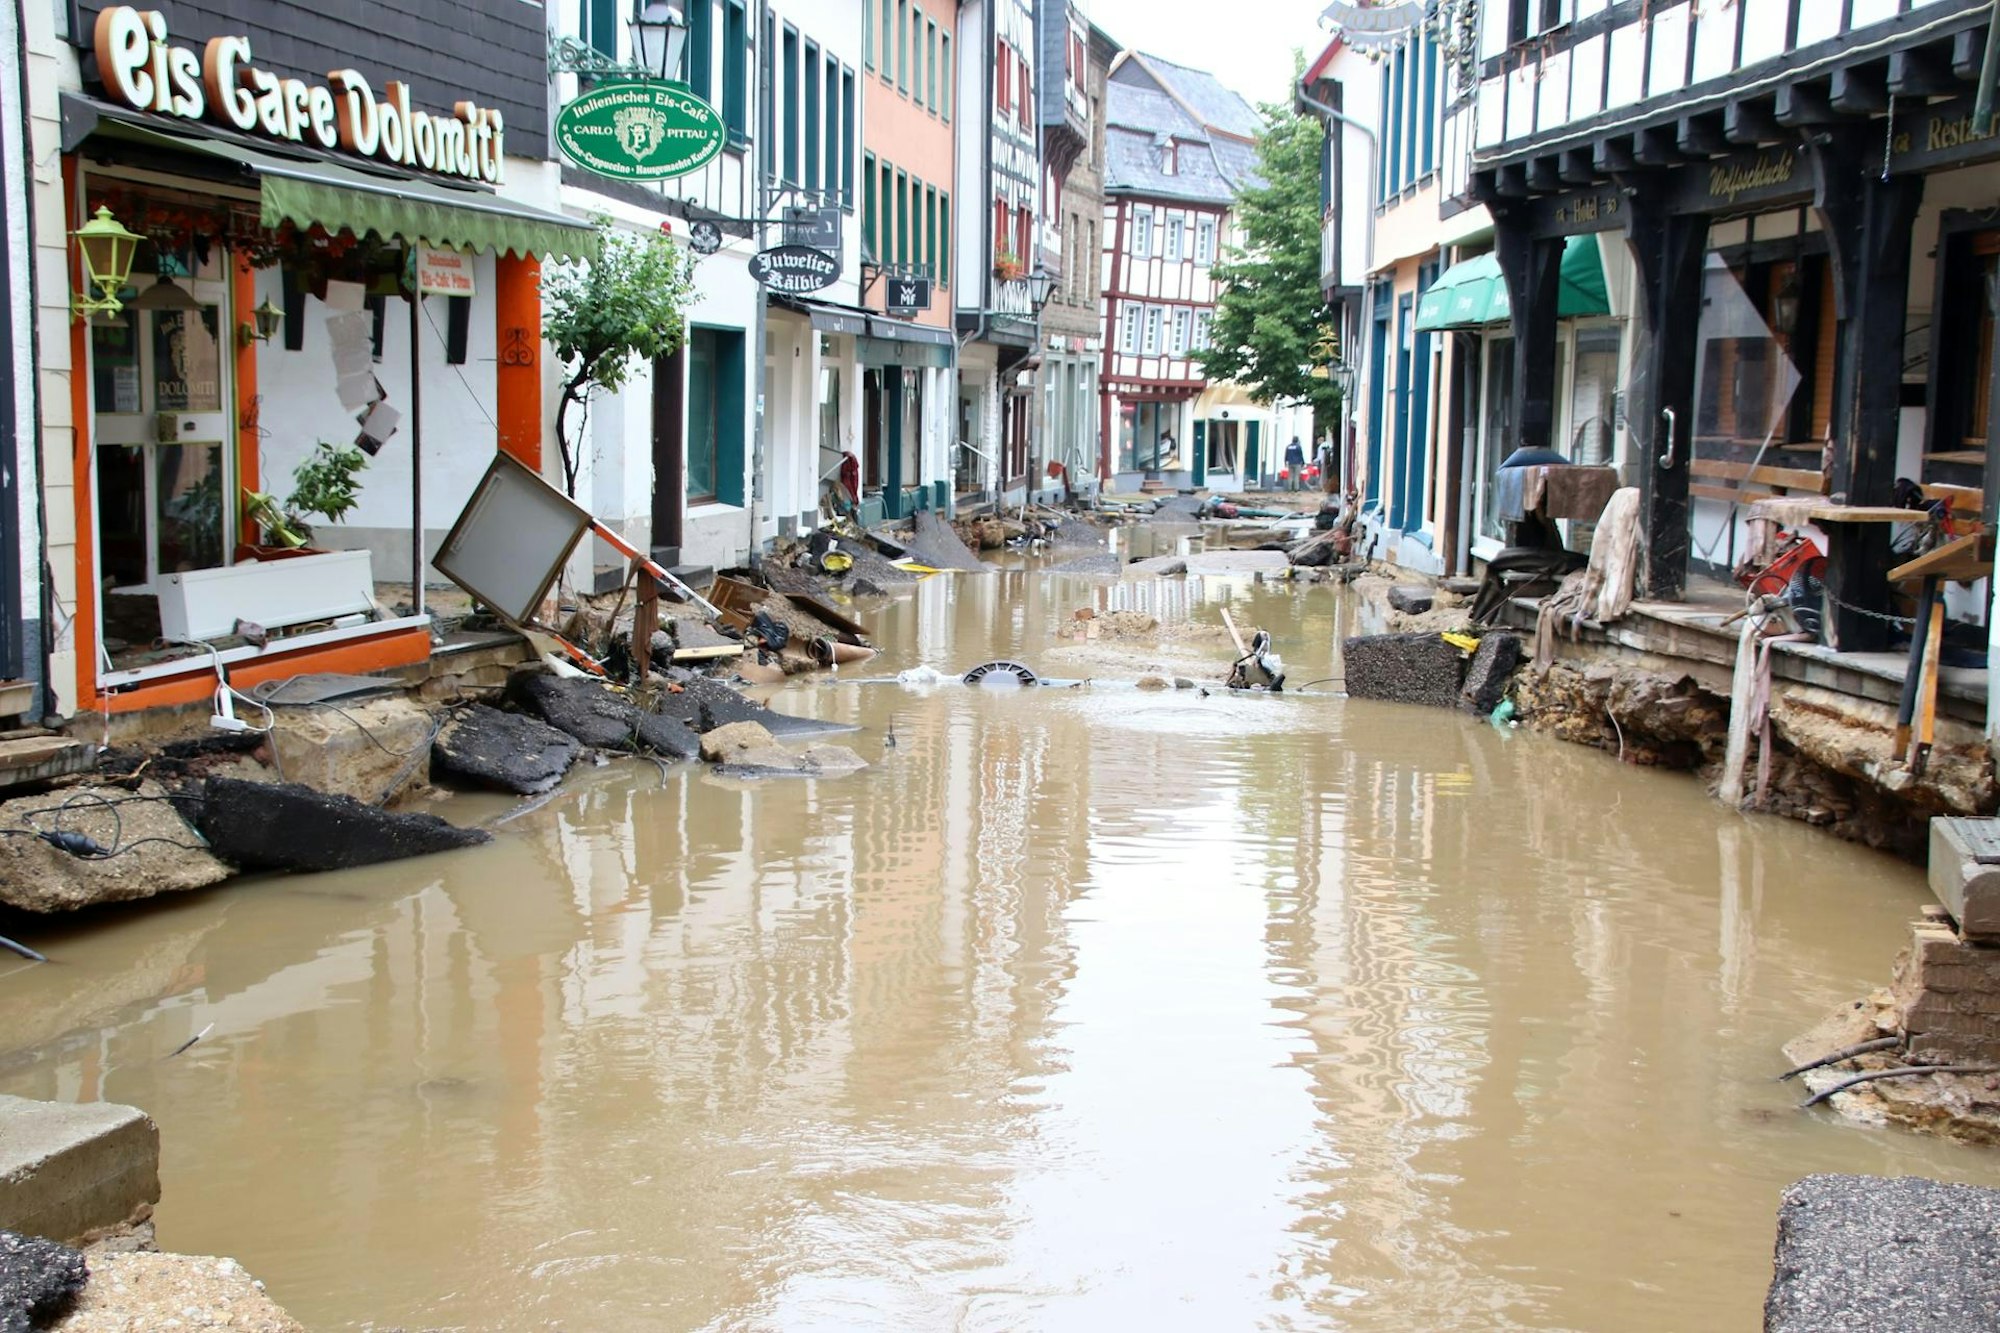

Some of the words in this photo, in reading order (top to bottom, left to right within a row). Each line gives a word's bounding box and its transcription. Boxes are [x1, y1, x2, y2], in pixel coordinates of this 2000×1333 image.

[95, 5, 204, 119] eis
[328, 68, 505, 185] Dolomiti
[573, 90, 650, 119] Italienisches
[655, 92, 710, 124] Eis-Café
[573, 124, 614, 135] CARLO
[667, 128, 708, 139] PITTAU
[635, 157, 692, 176] Hausgemachte
[689, 139, 718, 165] Kuchen
[1573, 195, 1598, 223] Hotel
[757, 253, 835, 275] Juwelier
[762, 269, 825, 291] Kälble
